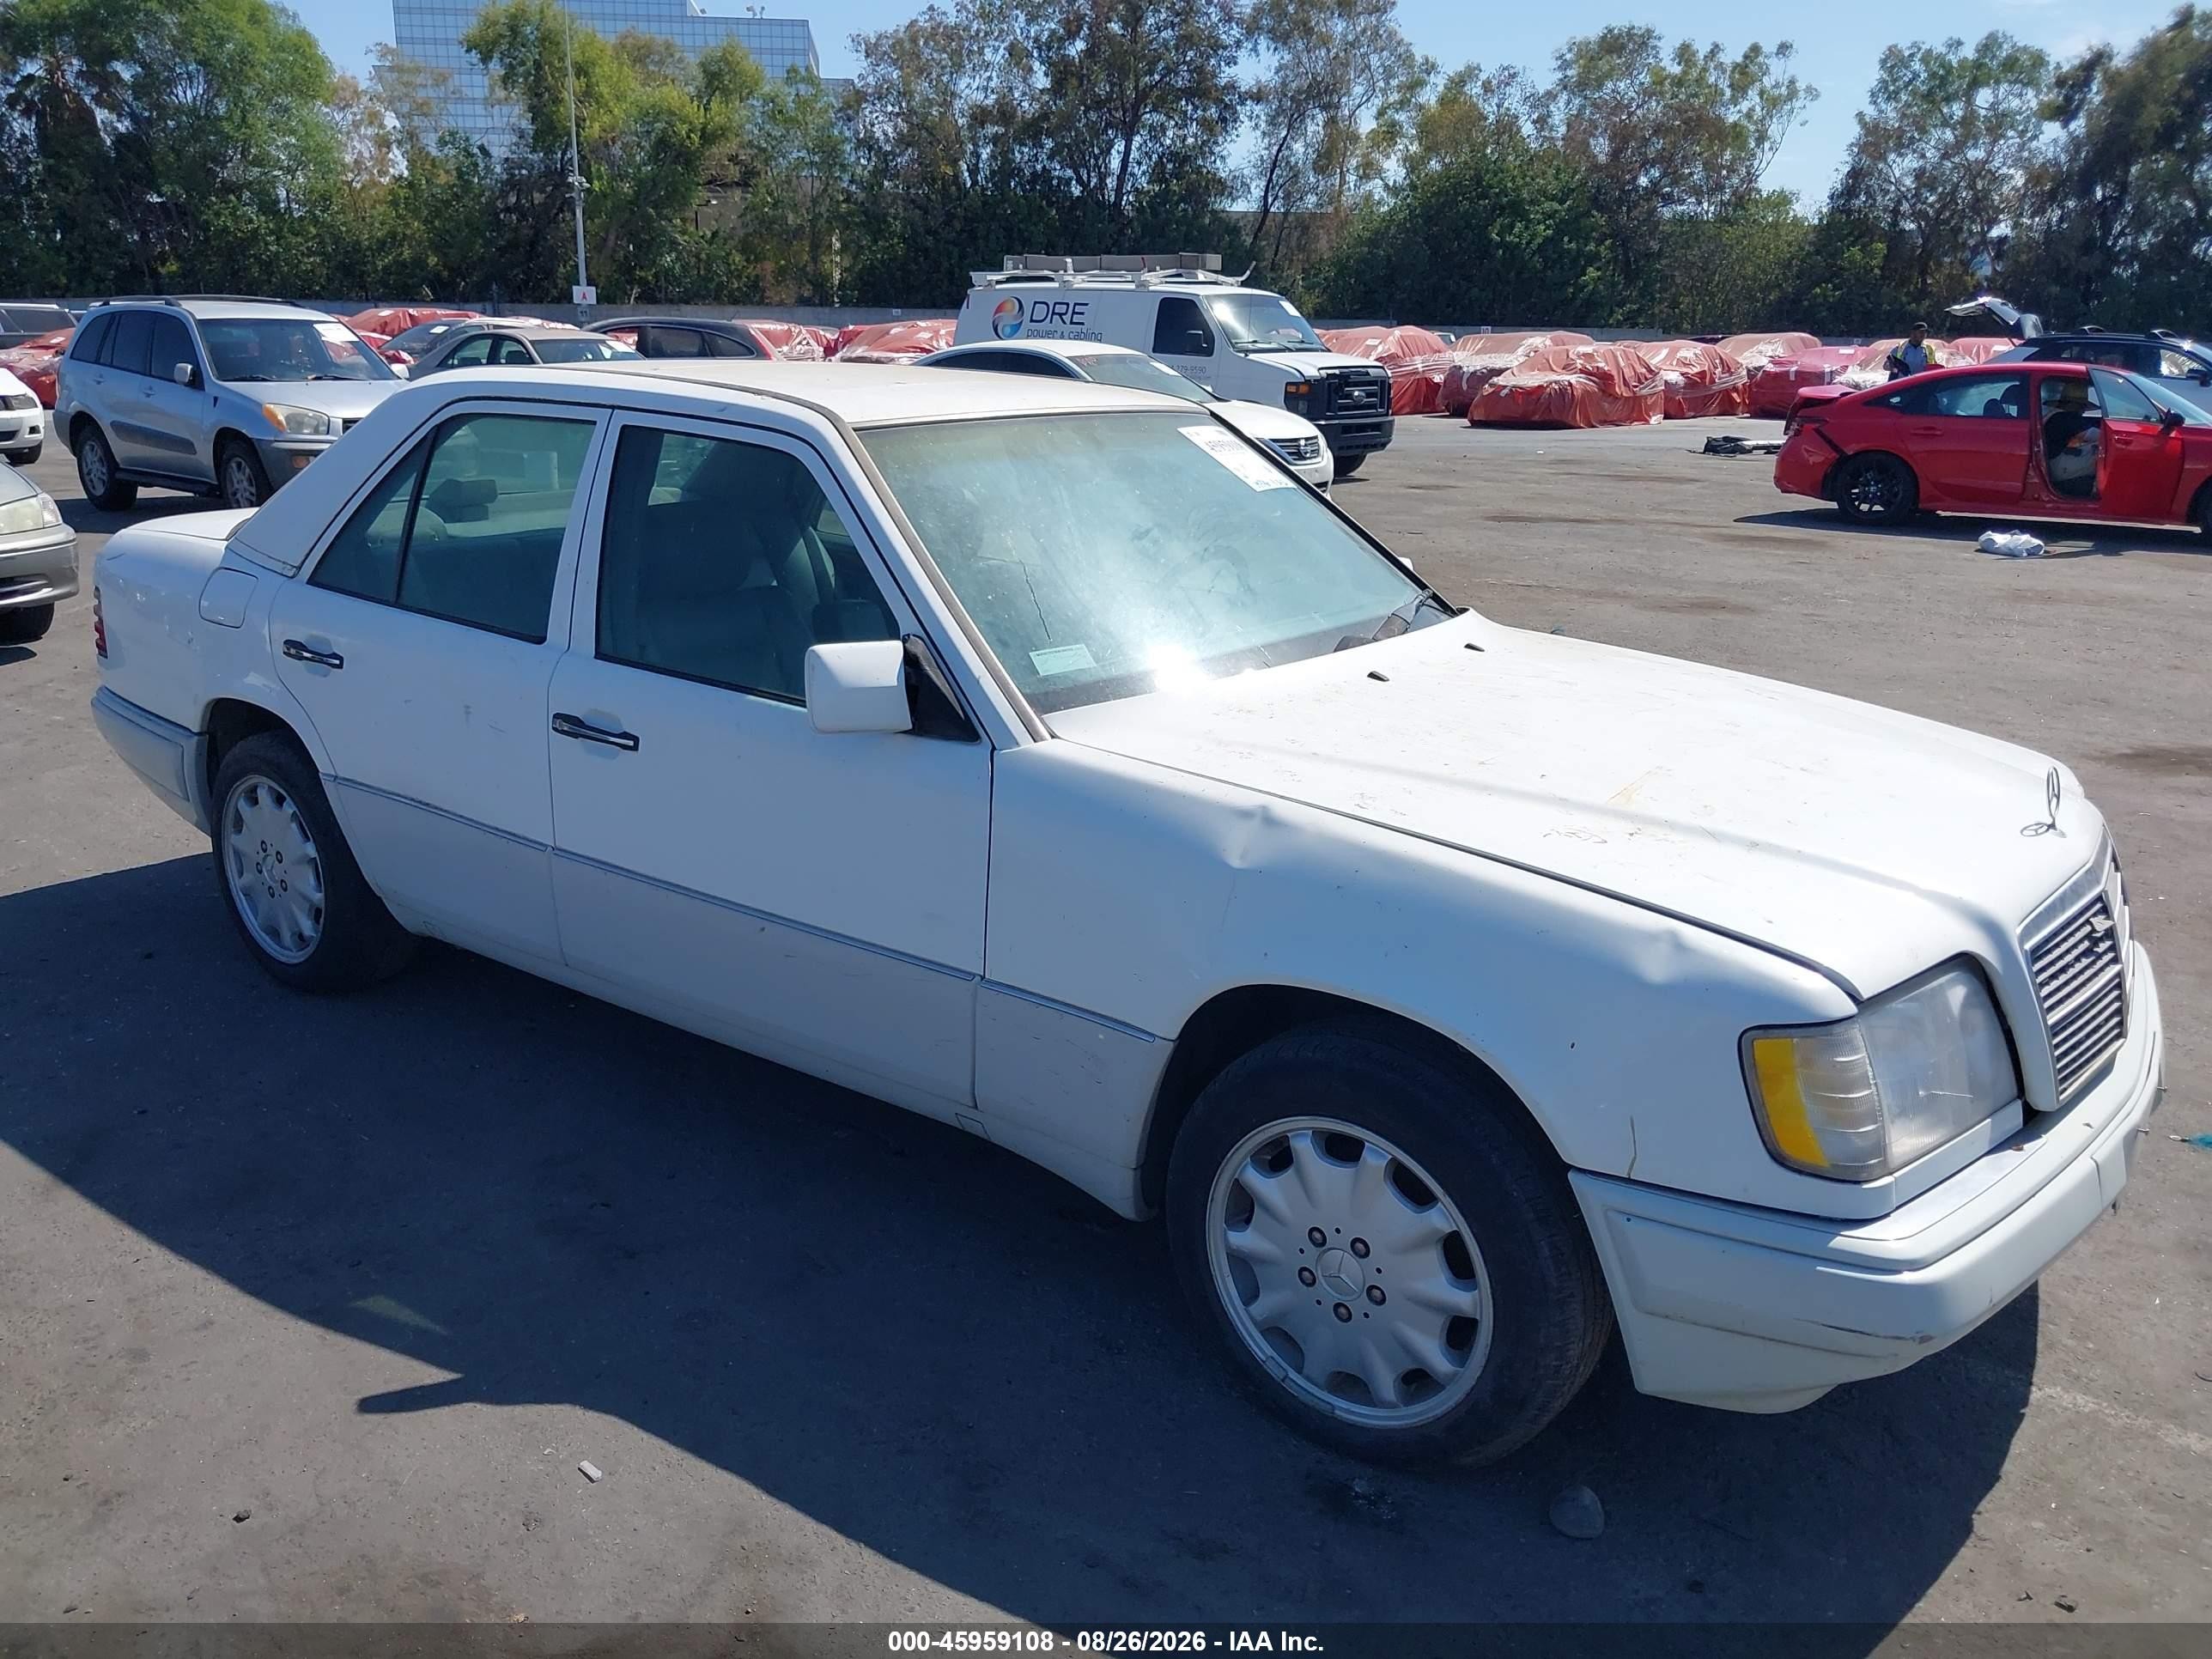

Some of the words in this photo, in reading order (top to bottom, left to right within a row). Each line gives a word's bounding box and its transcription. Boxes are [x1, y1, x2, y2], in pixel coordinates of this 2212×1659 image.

[580, 291, 588, 301] A
[1029, 301, 1091, 326] DRE
[1026, 328, 1058, 338] power
[1068, 328, 1103, 343] cabling
